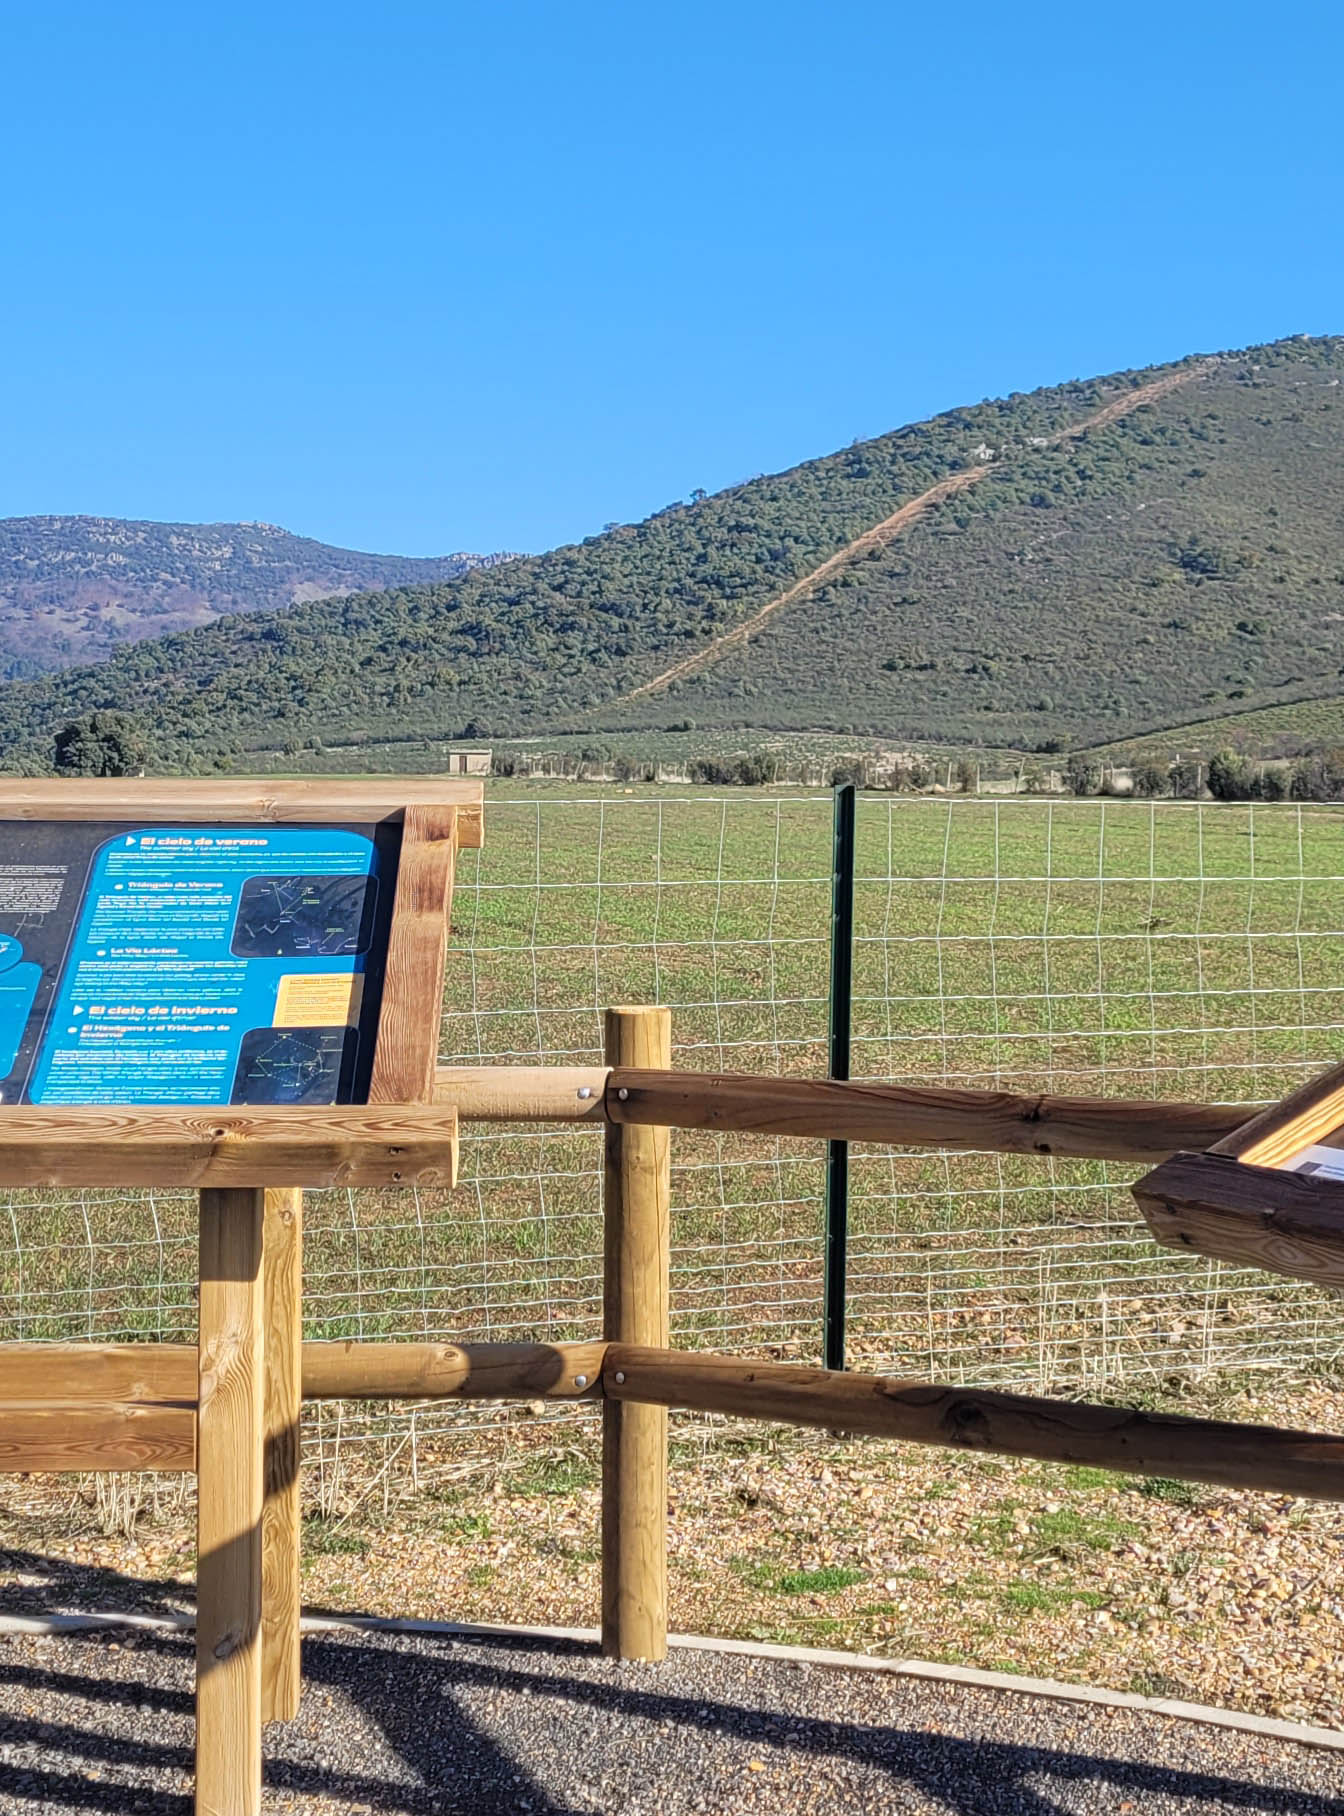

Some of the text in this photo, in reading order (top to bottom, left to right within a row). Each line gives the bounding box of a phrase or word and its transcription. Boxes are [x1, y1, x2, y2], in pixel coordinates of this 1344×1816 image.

[140, 837, 268, 846] El cielo de verano
[89, 1006, 105, 1014] El
[107, 1006, 145, 1014] cielo
[148, 1006, 168, 1014] de
